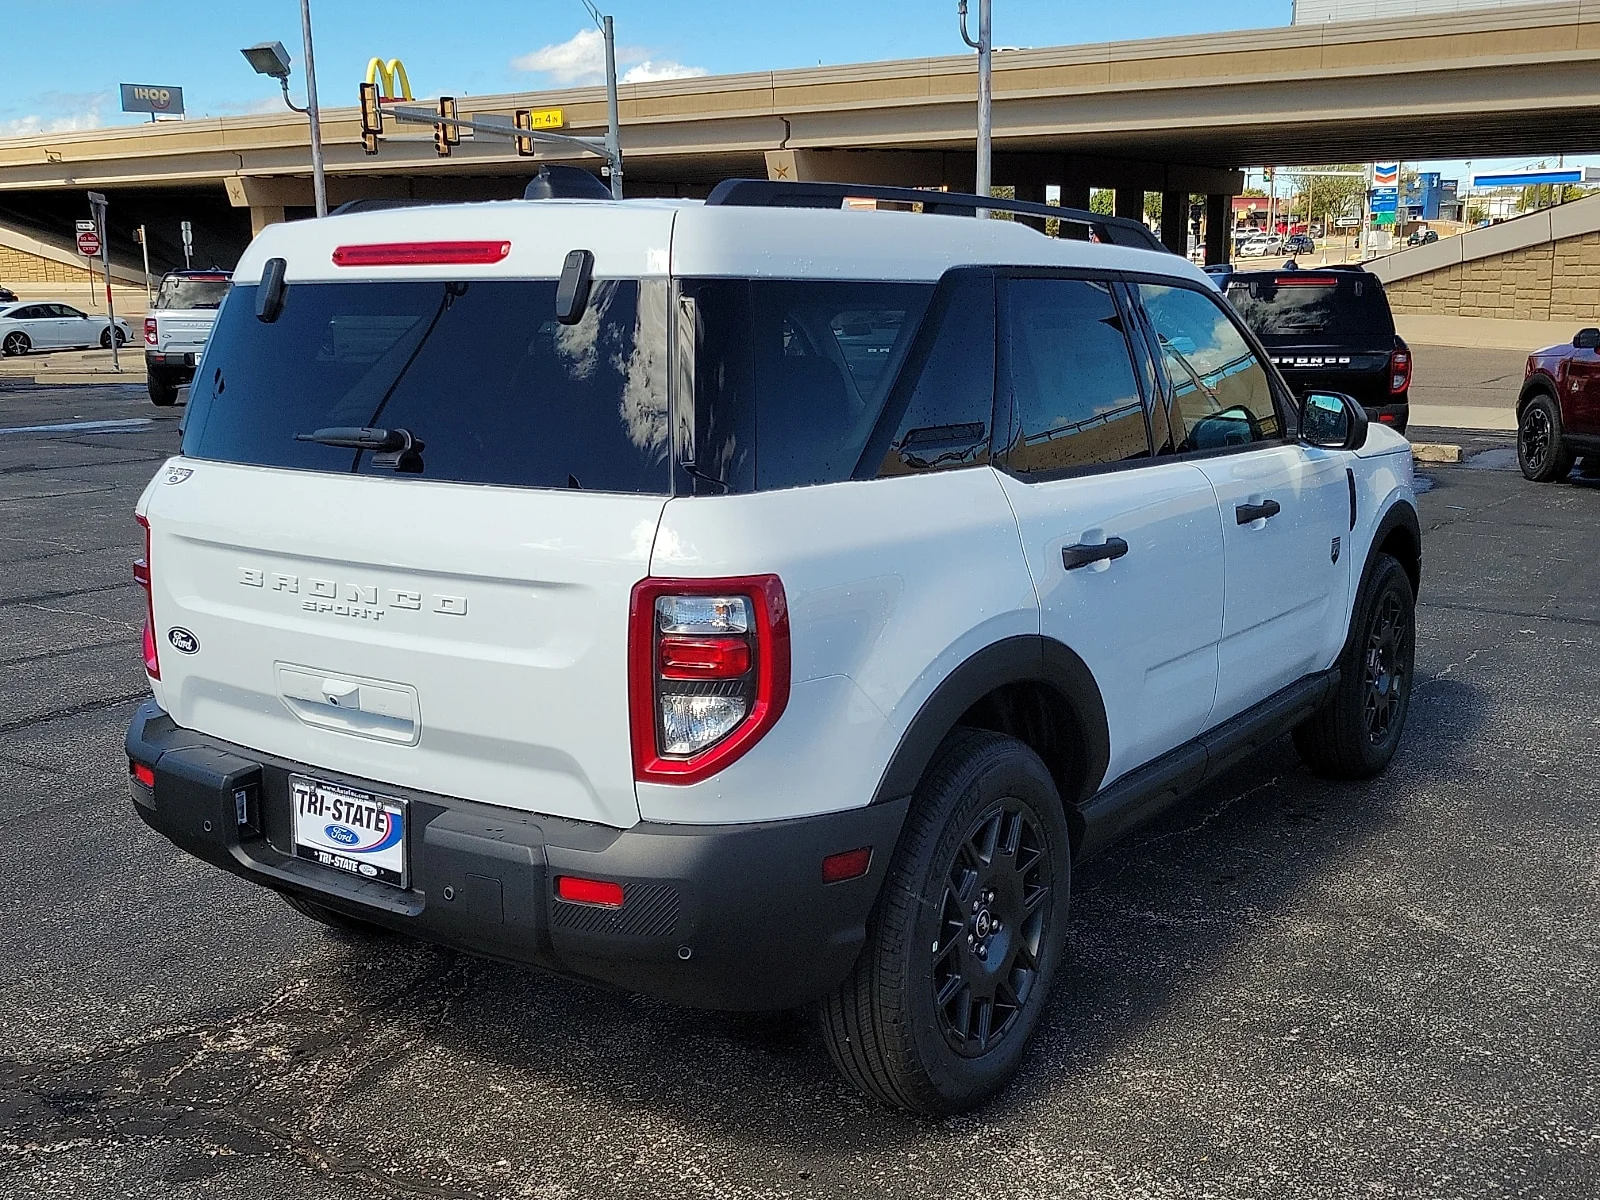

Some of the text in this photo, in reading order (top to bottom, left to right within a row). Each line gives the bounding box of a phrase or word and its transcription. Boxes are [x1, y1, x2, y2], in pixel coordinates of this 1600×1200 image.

[134, 87, 170, 105] IHOP
[545, 114, 552, 124] 4
[238, 567, 468, 616] BRONCO
[301, 599, 385, 621] SPORT
[172, 631, 193, 651] Ford
[296, 789, 385, 832] TRI-STATE
[331, 826, 353, 843] Ford
[319, 852, 358, 872] TRI-STATE
